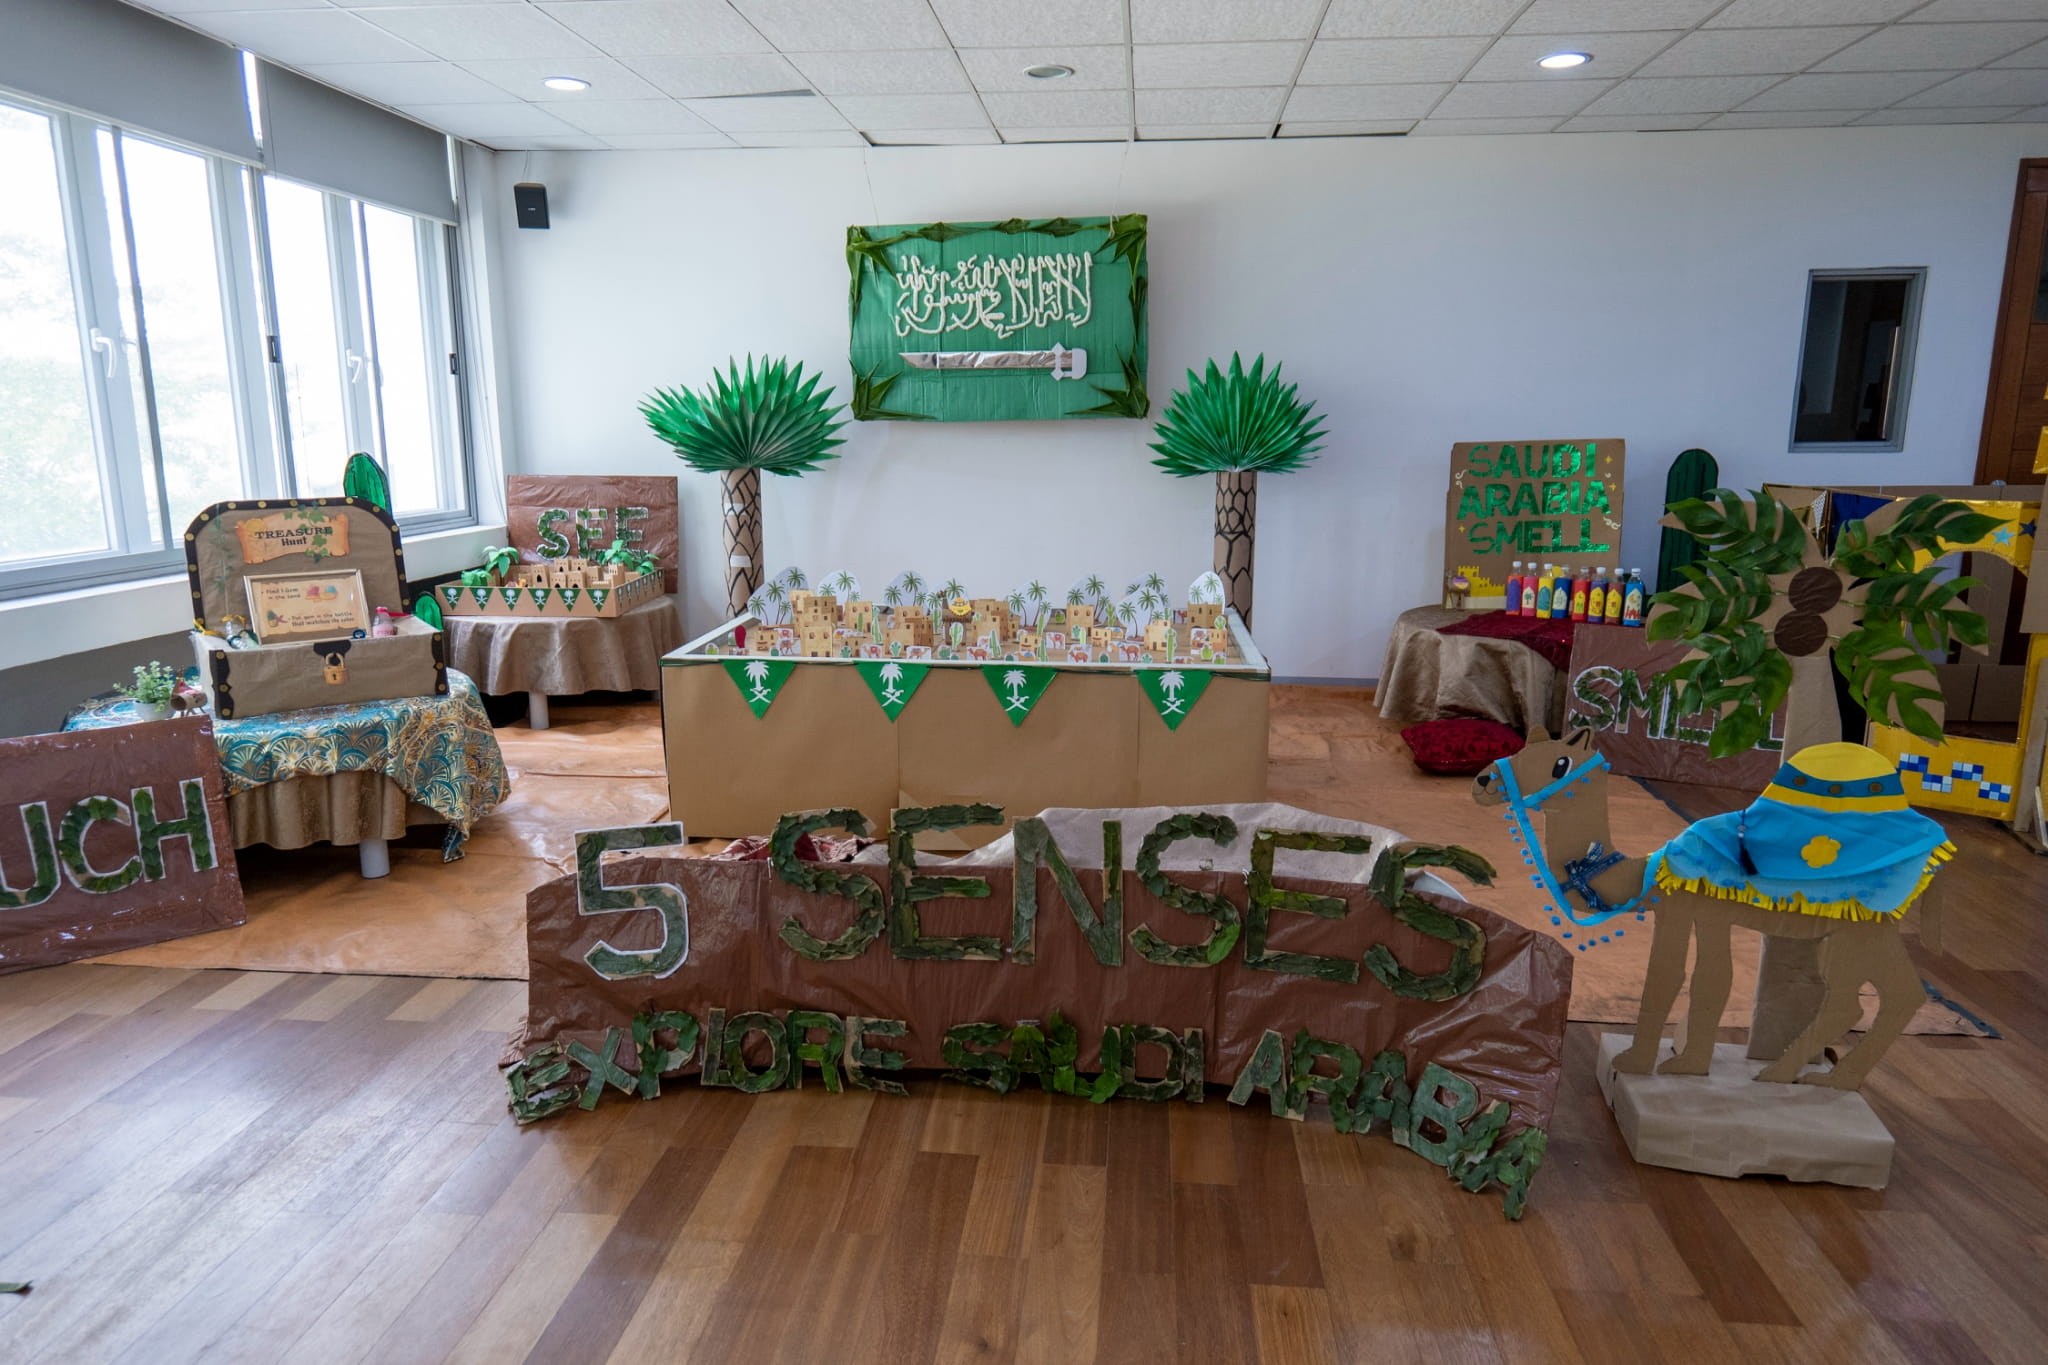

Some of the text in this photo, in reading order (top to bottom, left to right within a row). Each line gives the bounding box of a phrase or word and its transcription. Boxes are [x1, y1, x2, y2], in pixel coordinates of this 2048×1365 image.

[1468, 443, 1597, 478] SAUDI
[1456, 480, 1611, 520] ARABIA
[254, 526, 333, 539] TREASURE
[281, 536, 307, 546] Hunt
[536, 506, 649, 561] SEE
[1468, 519, 1610, 555] SMELL
[574, 802, 1498, 1002] 5 SENSES
[505, 1007, 1548, 1222] EXPLORE SAUDI ARABIA
